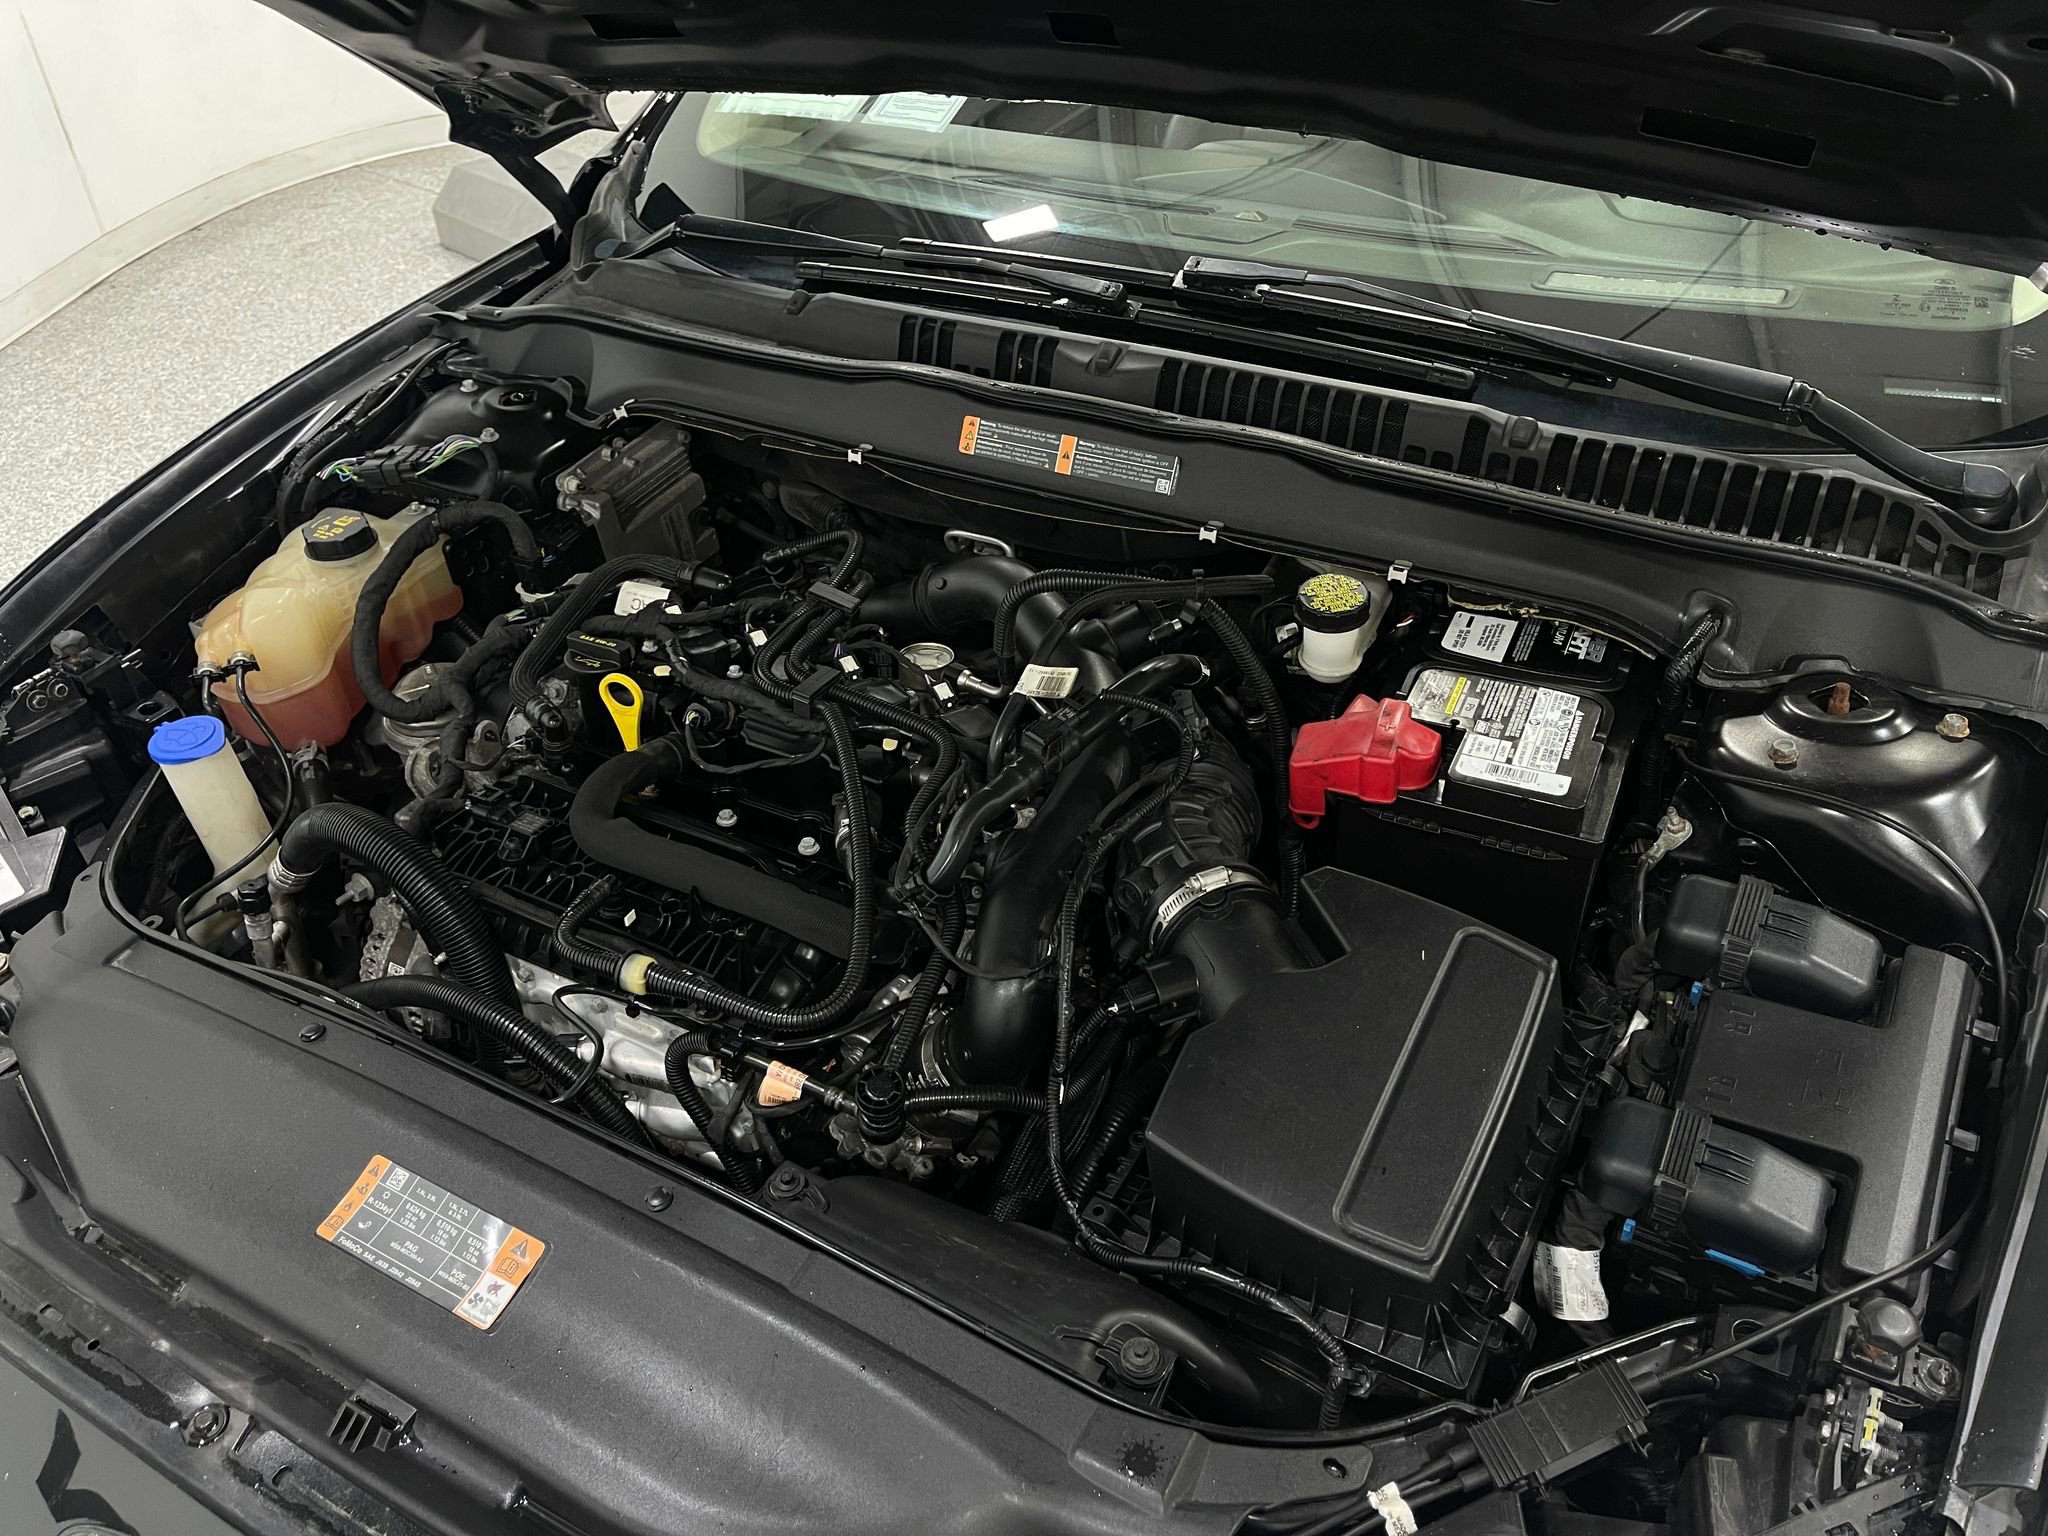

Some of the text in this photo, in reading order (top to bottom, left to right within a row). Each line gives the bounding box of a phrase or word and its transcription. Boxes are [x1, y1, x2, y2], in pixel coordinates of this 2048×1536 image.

[365, 1196, 393, 1216] R-1234yf
[337, 1235, 363, 1254] FoMoCo
[362, 1250, 375, 1261] SAE
[374, 1258, 389, 1269] J639
[403, 1240, 418, 1253] PAG
[449, 1268, 466, 1281] POE
